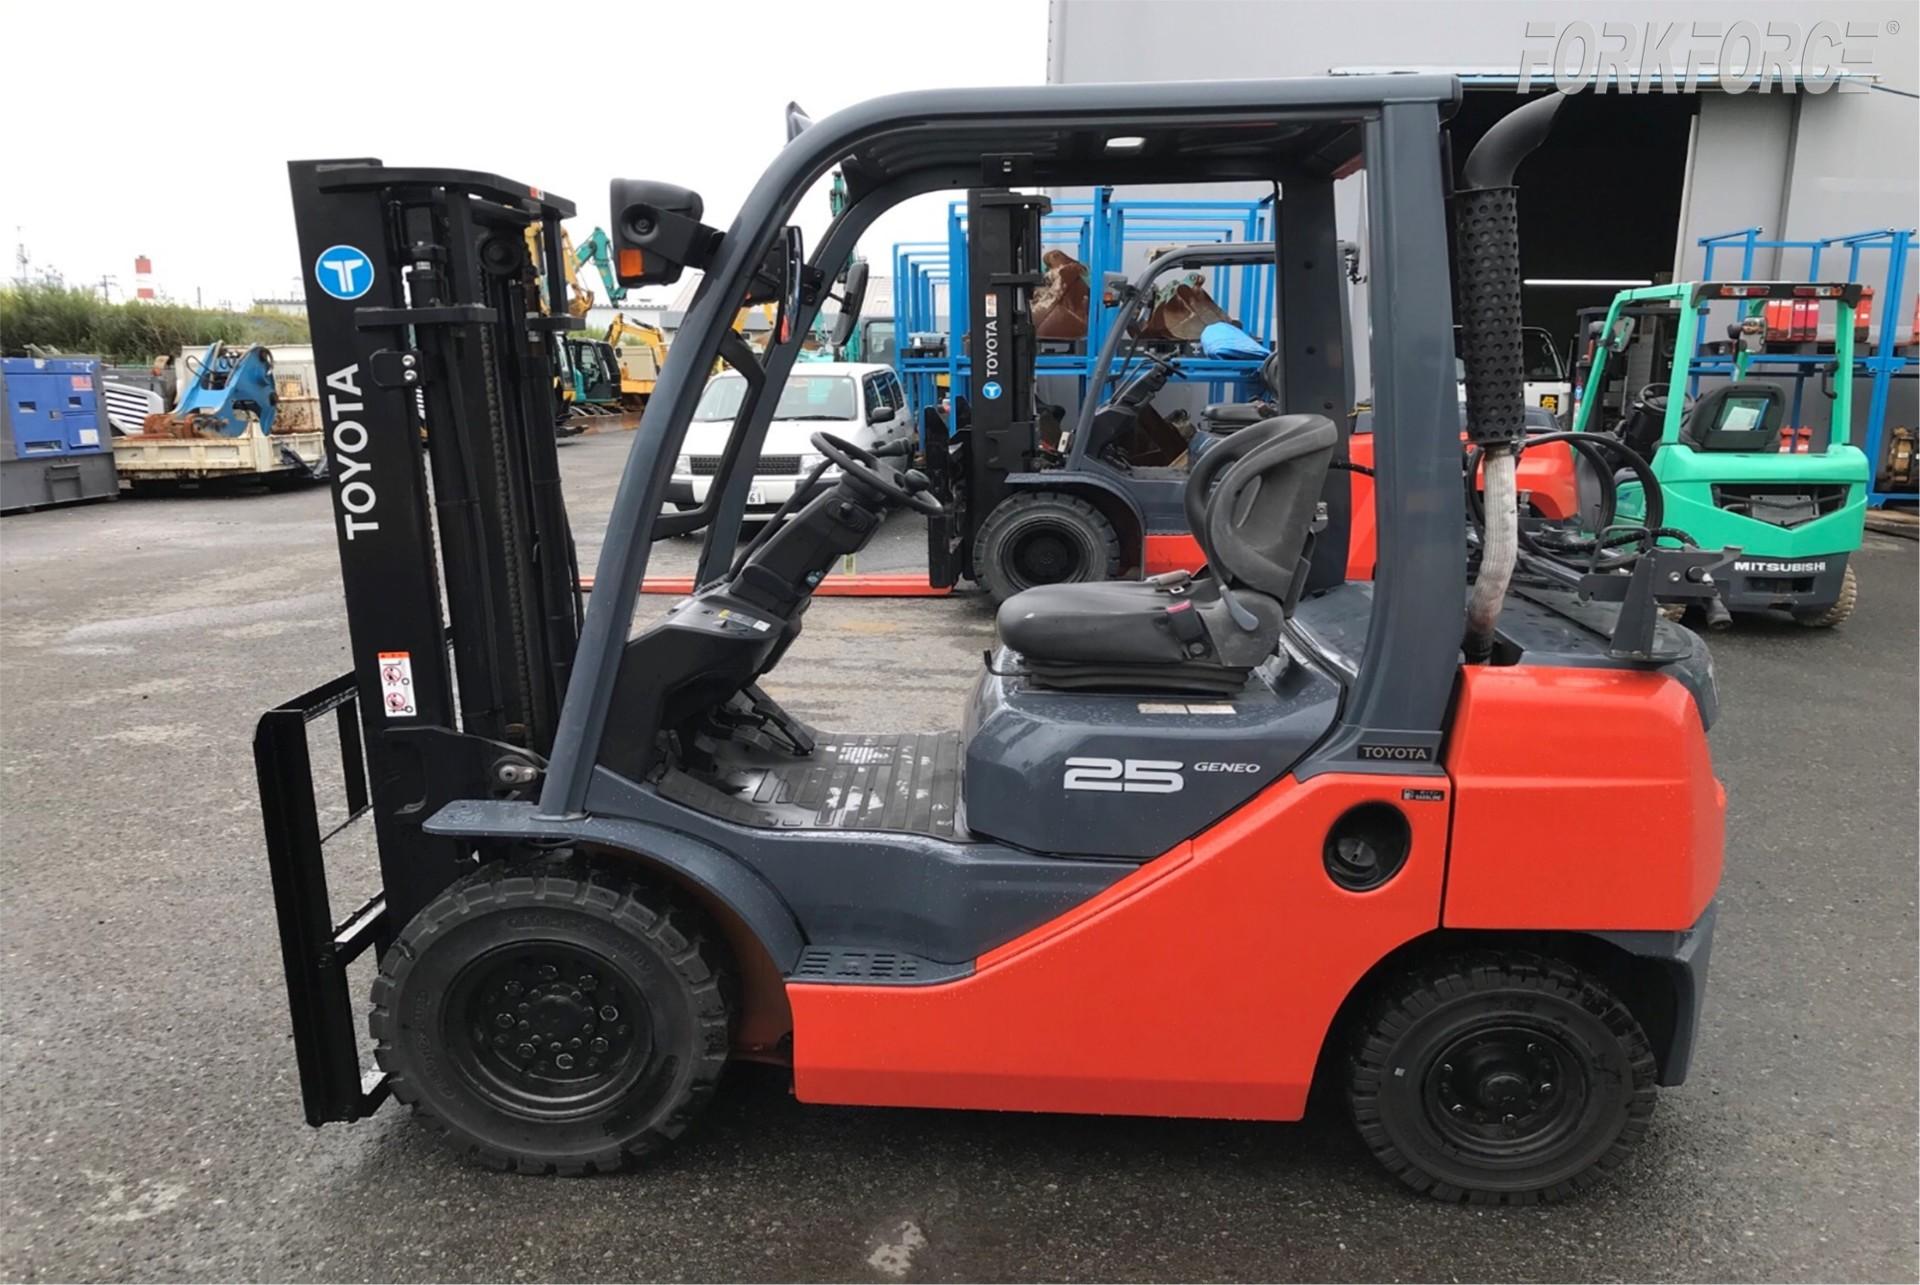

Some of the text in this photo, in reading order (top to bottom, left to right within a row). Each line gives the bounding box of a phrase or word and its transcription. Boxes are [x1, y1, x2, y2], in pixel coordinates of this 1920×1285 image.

[985, 320, 998, 378] TOYOTA
[326, 363, 380, 541] TOYOTA
[1733, 561, 1826, 572] MITSUBISHI
[1362, 747, 1427, 759] TOYOTA
[1063, 756, 1261, 794] 25 GENEO
